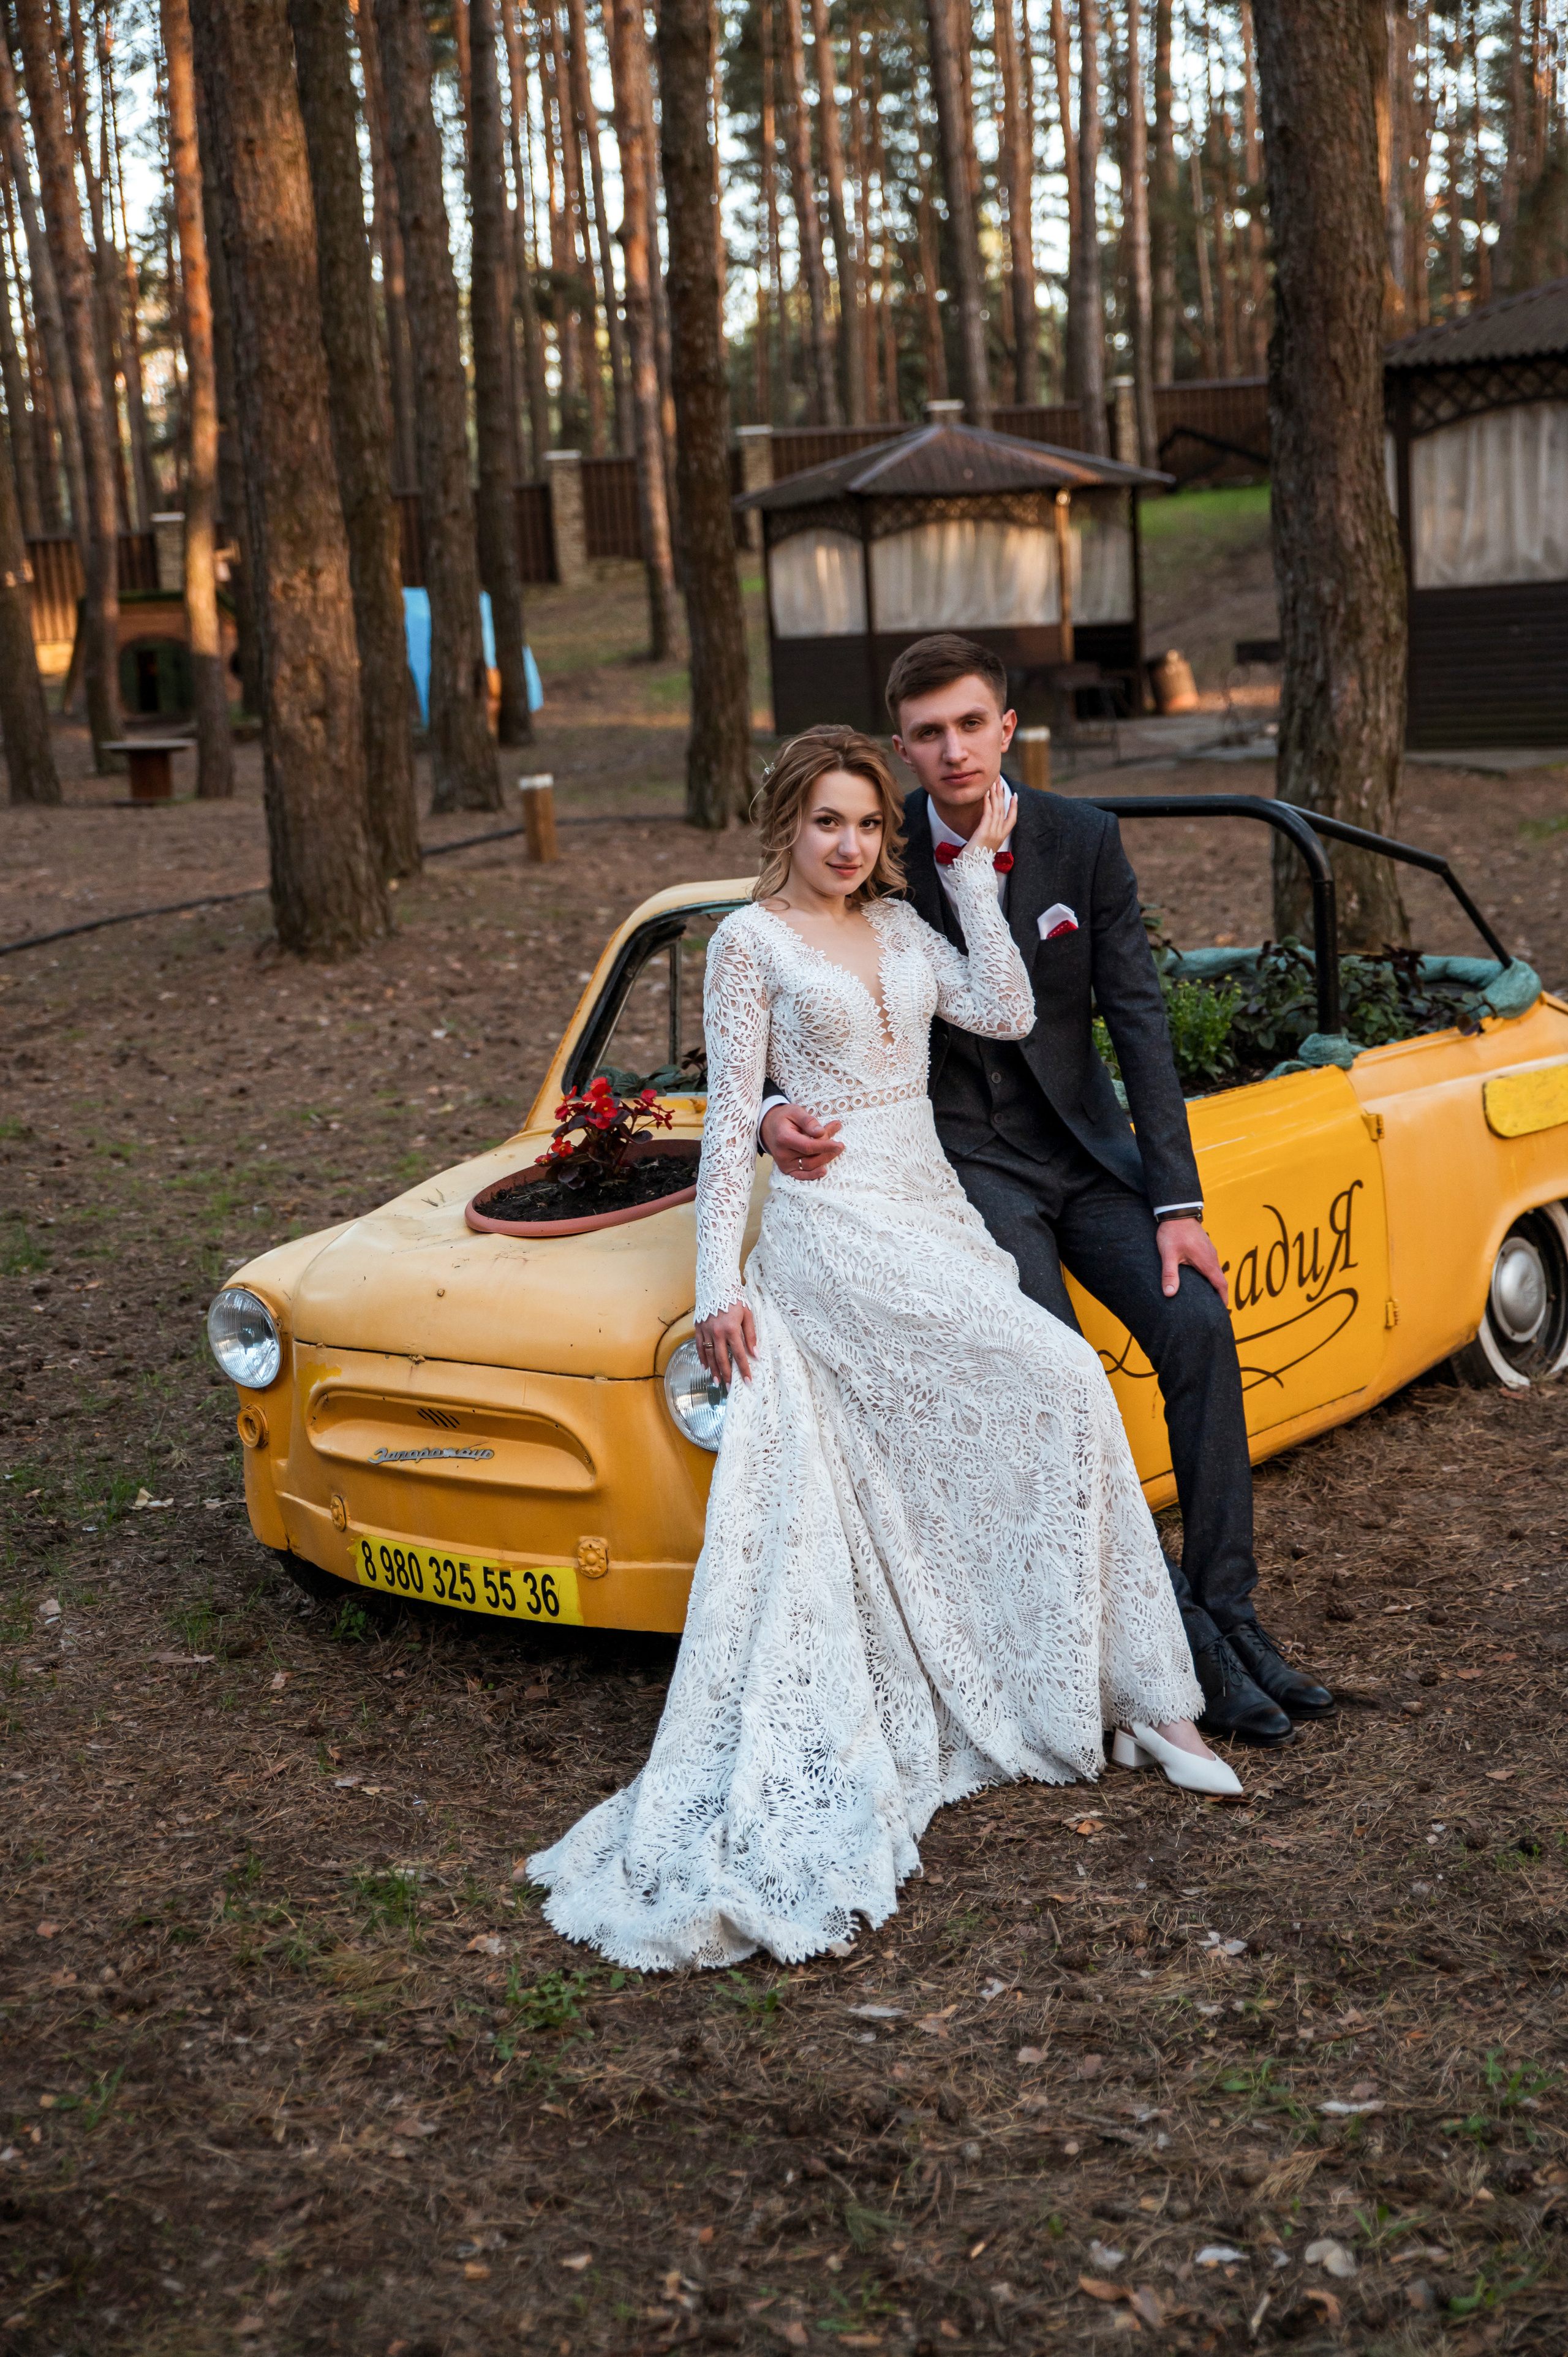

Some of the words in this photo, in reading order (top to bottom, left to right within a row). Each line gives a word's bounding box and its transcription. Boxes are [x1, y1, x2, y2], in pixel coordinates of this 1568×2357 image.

[361, 1540, 377, 1582] 8
[379, 1545, 424, 1594] 980
[428, 1556, 476, 1605] 325
[483, 1566, 516, 1612] 55
[522, 1571, 560, 1617] 36
